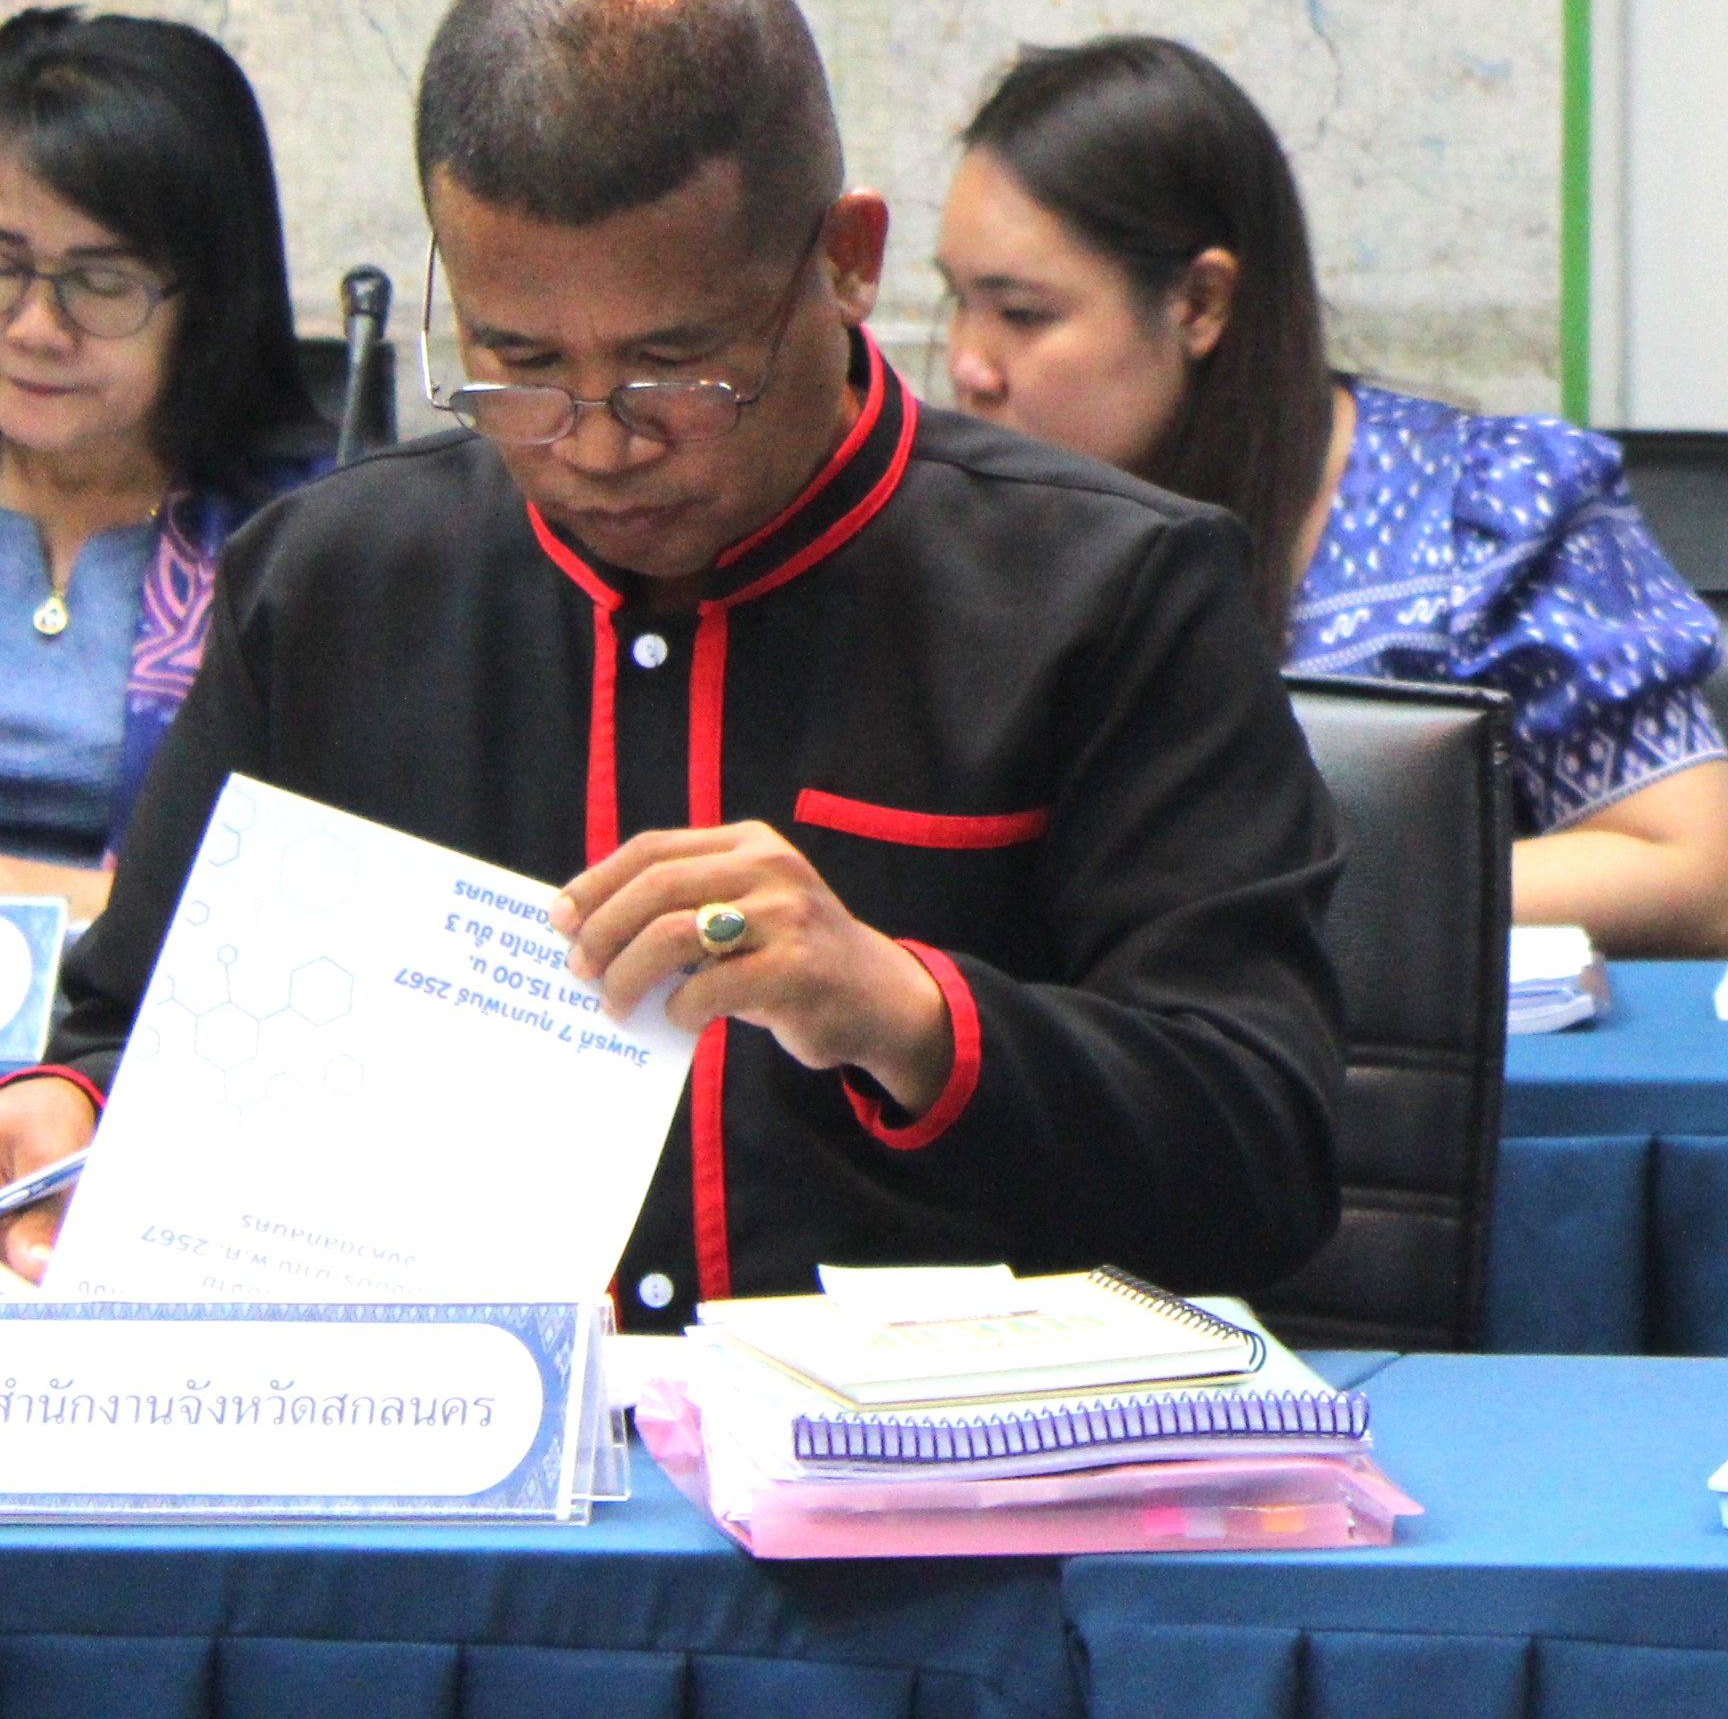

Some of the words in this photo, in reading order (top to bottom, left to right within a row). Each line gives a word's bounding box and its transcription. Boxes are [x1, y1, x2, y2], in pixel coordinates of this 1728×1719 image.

[444, 912, 461, 933] 3
[393, 968, 453, 1000] 2567
[492, 965, 551, 1000] 15.00
[557, 1024, 573, 1042] 7
[140, 1225, 210, 1257] 2567
